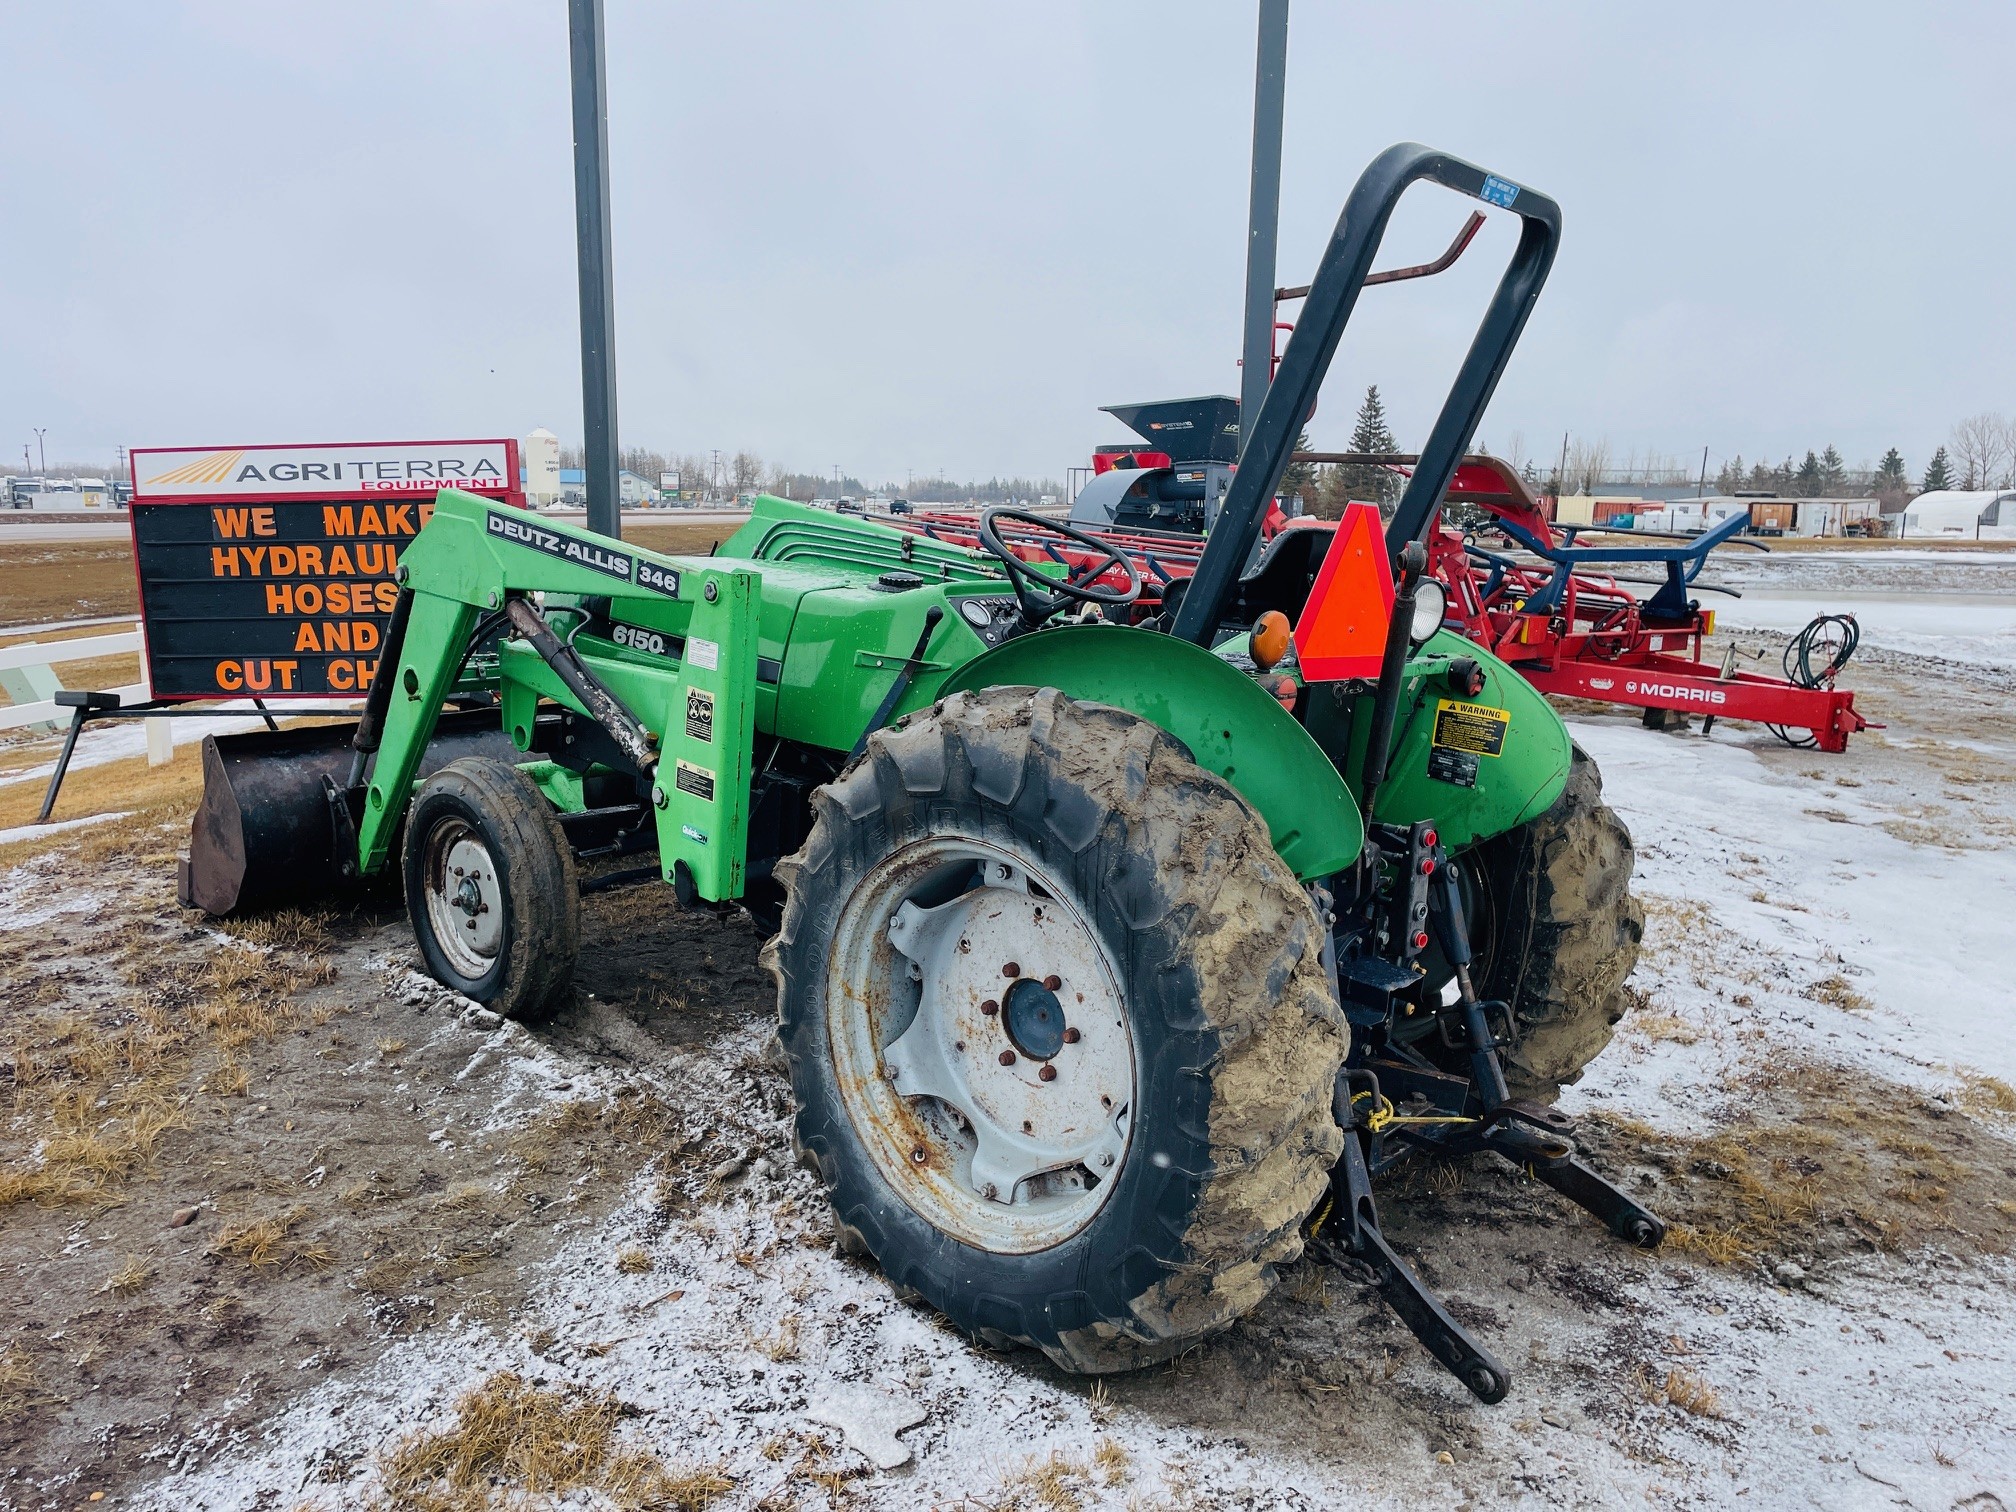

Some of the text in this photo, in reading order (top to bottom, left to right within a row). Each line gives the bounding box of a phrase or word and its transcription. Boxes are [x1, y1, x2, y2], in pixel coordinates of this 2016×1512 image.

[236, 458, 501, 482] AGRITERRA
[361, 478, 503, 490] EQUIPMENT
[213, 507, 277, 538] WE
[639, 566, 676, 591] 346
[265, 582, 398, 614] HOSES
[295, 622, 379, 651] AND
[613, 625, 664, 654] 6150
[216, 660, 298, 690] CUT
[1640, 682, 1726, 704] MORRIS
[1460, 704, 1501, 719] WARNING
